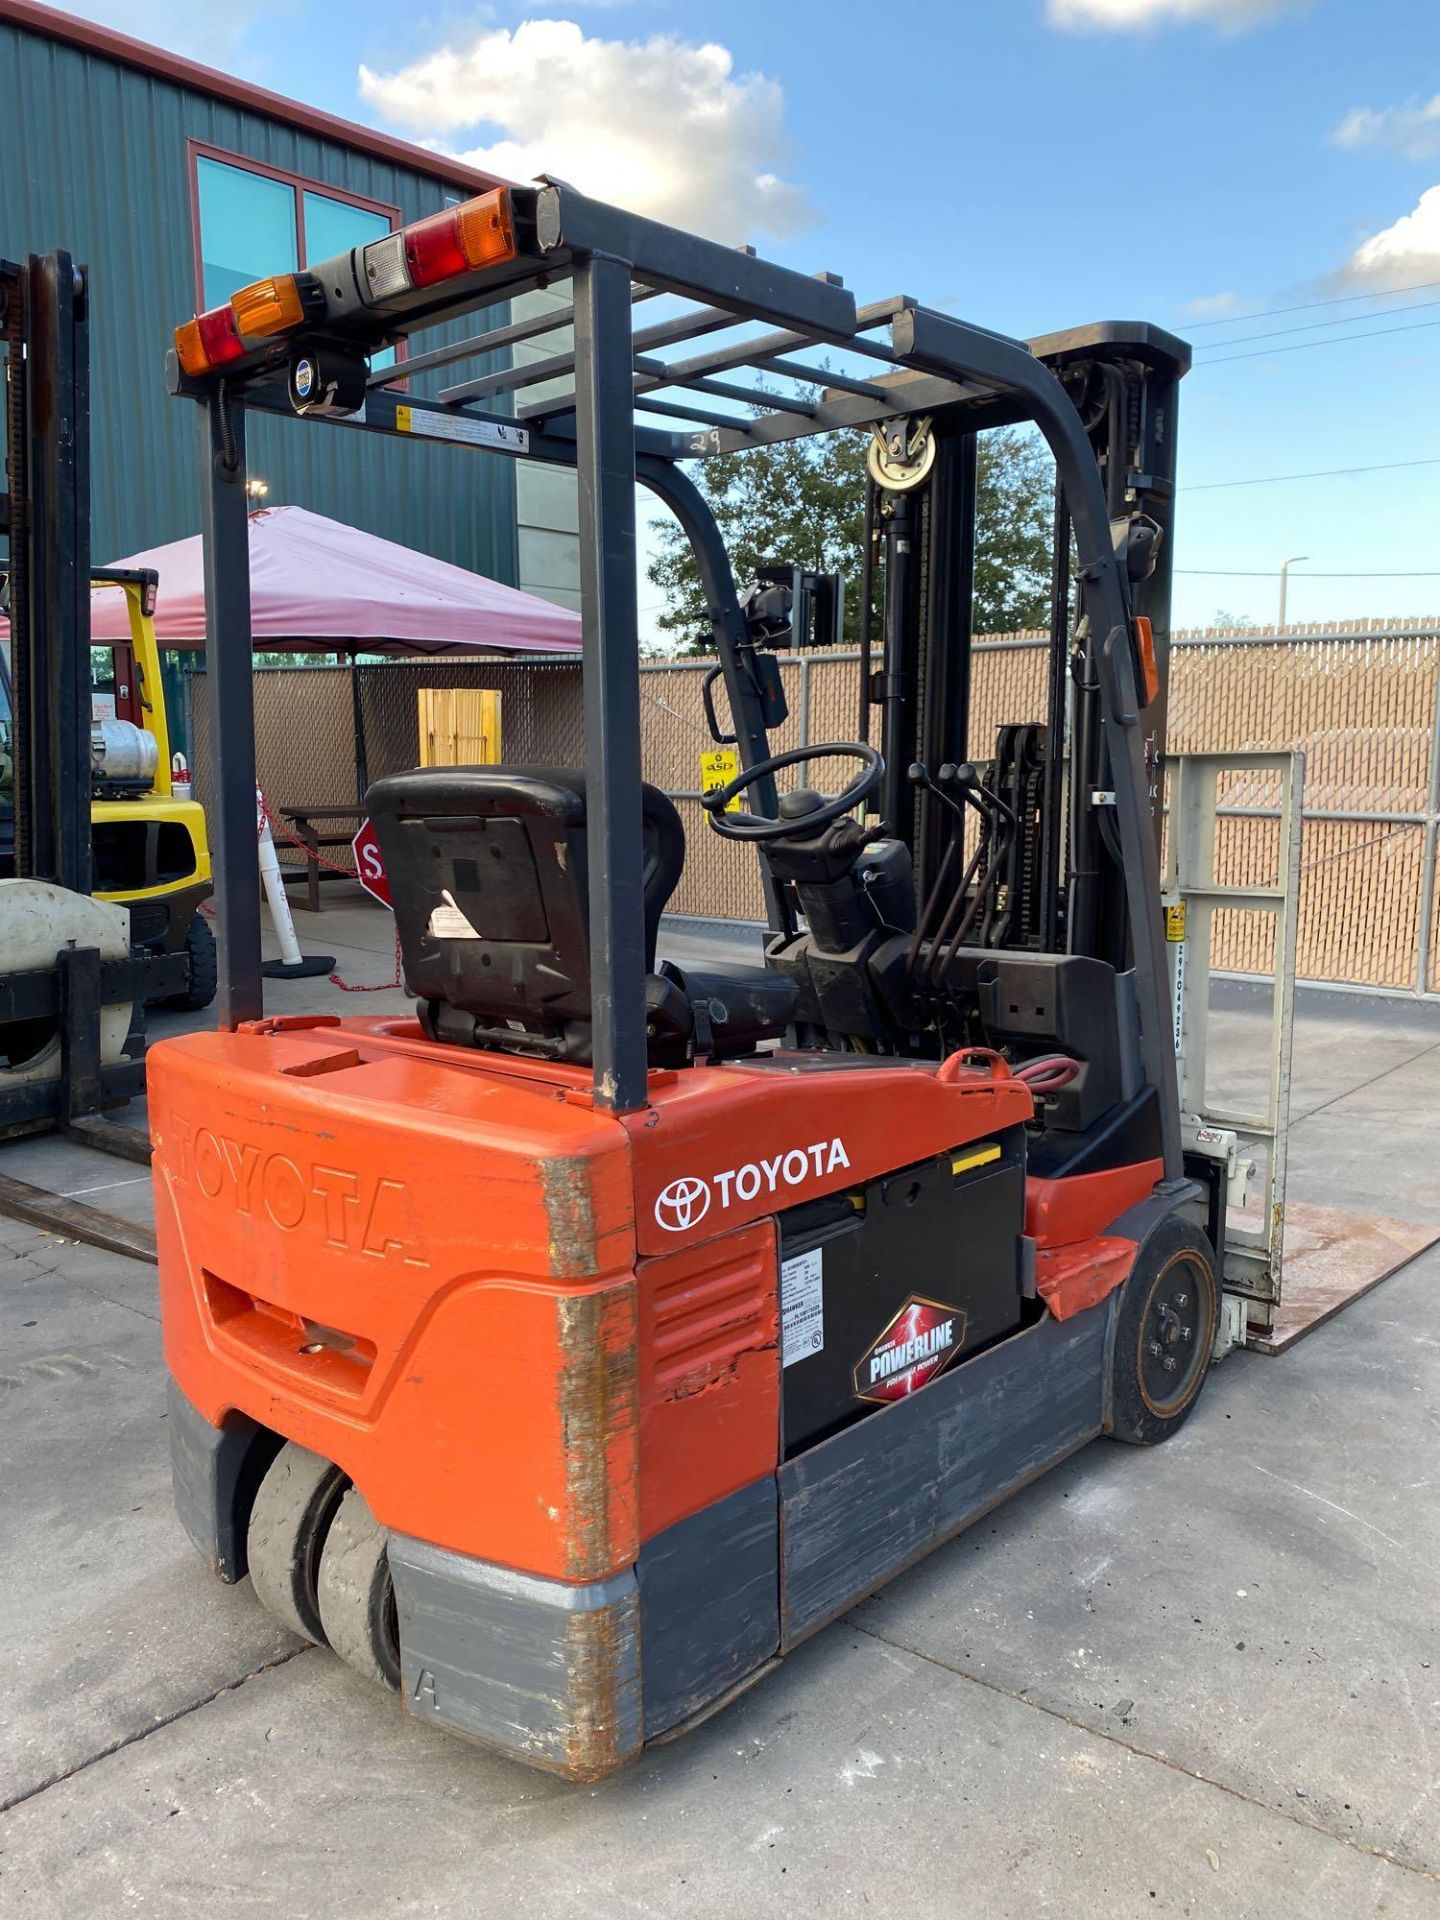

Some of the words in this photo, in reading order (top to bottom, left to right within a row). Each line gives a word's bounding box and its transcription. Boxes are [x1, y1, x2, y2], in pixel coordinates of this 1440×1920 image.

[690, 430, 720, 454] 29
[171, 1112, 431, 1268] TOYOTA
[713, 1138, 851, 1208] TOYOTA
[870, 1320, 953, 1384] POWERLINE
[916, 1355, 939, 1372] POWER
